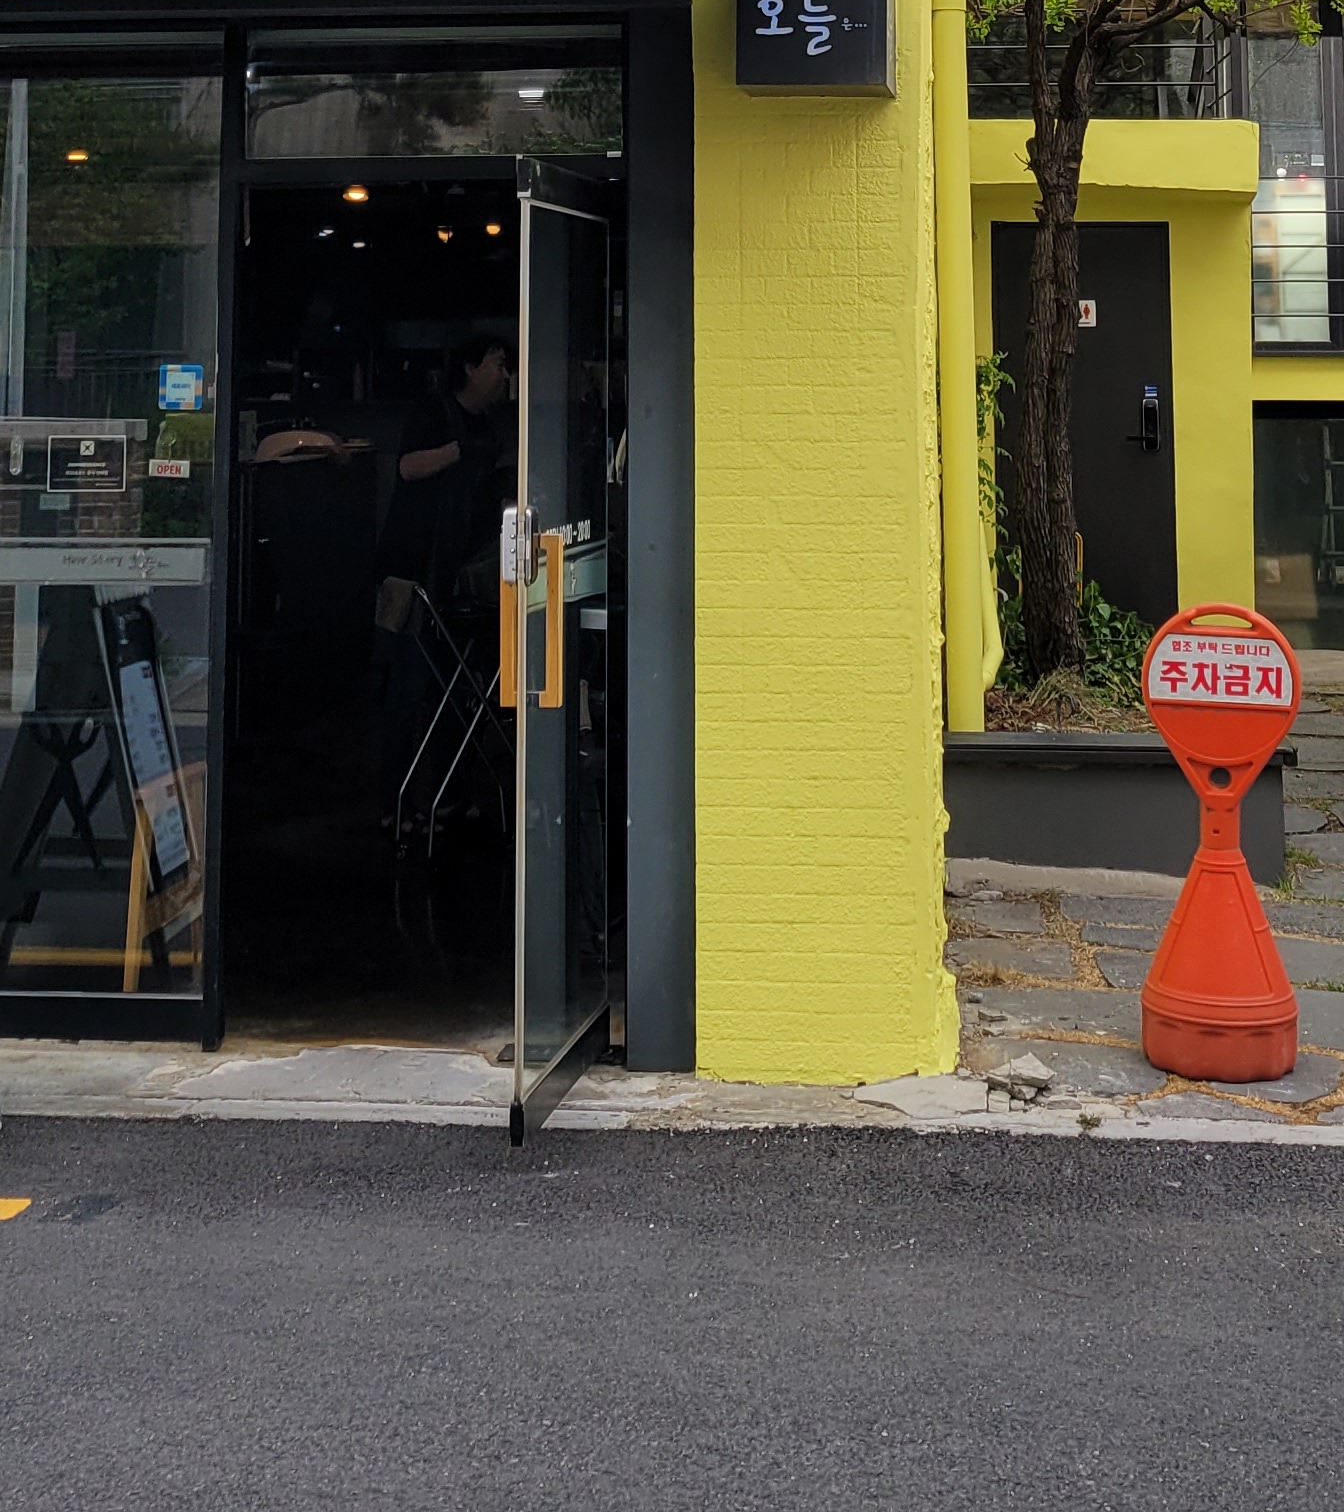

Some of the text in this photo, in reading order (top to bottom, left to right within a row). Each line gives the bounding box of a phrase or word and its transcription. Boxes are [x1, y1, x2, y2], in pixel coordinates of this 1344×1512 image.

[156, 464, 182, 475] OPEN
[1197, 641, 1218, 654] 부탁
[1221, 643, 1270, 657] 드립니다
[1160, 660, 1283, 700] 주차금지
